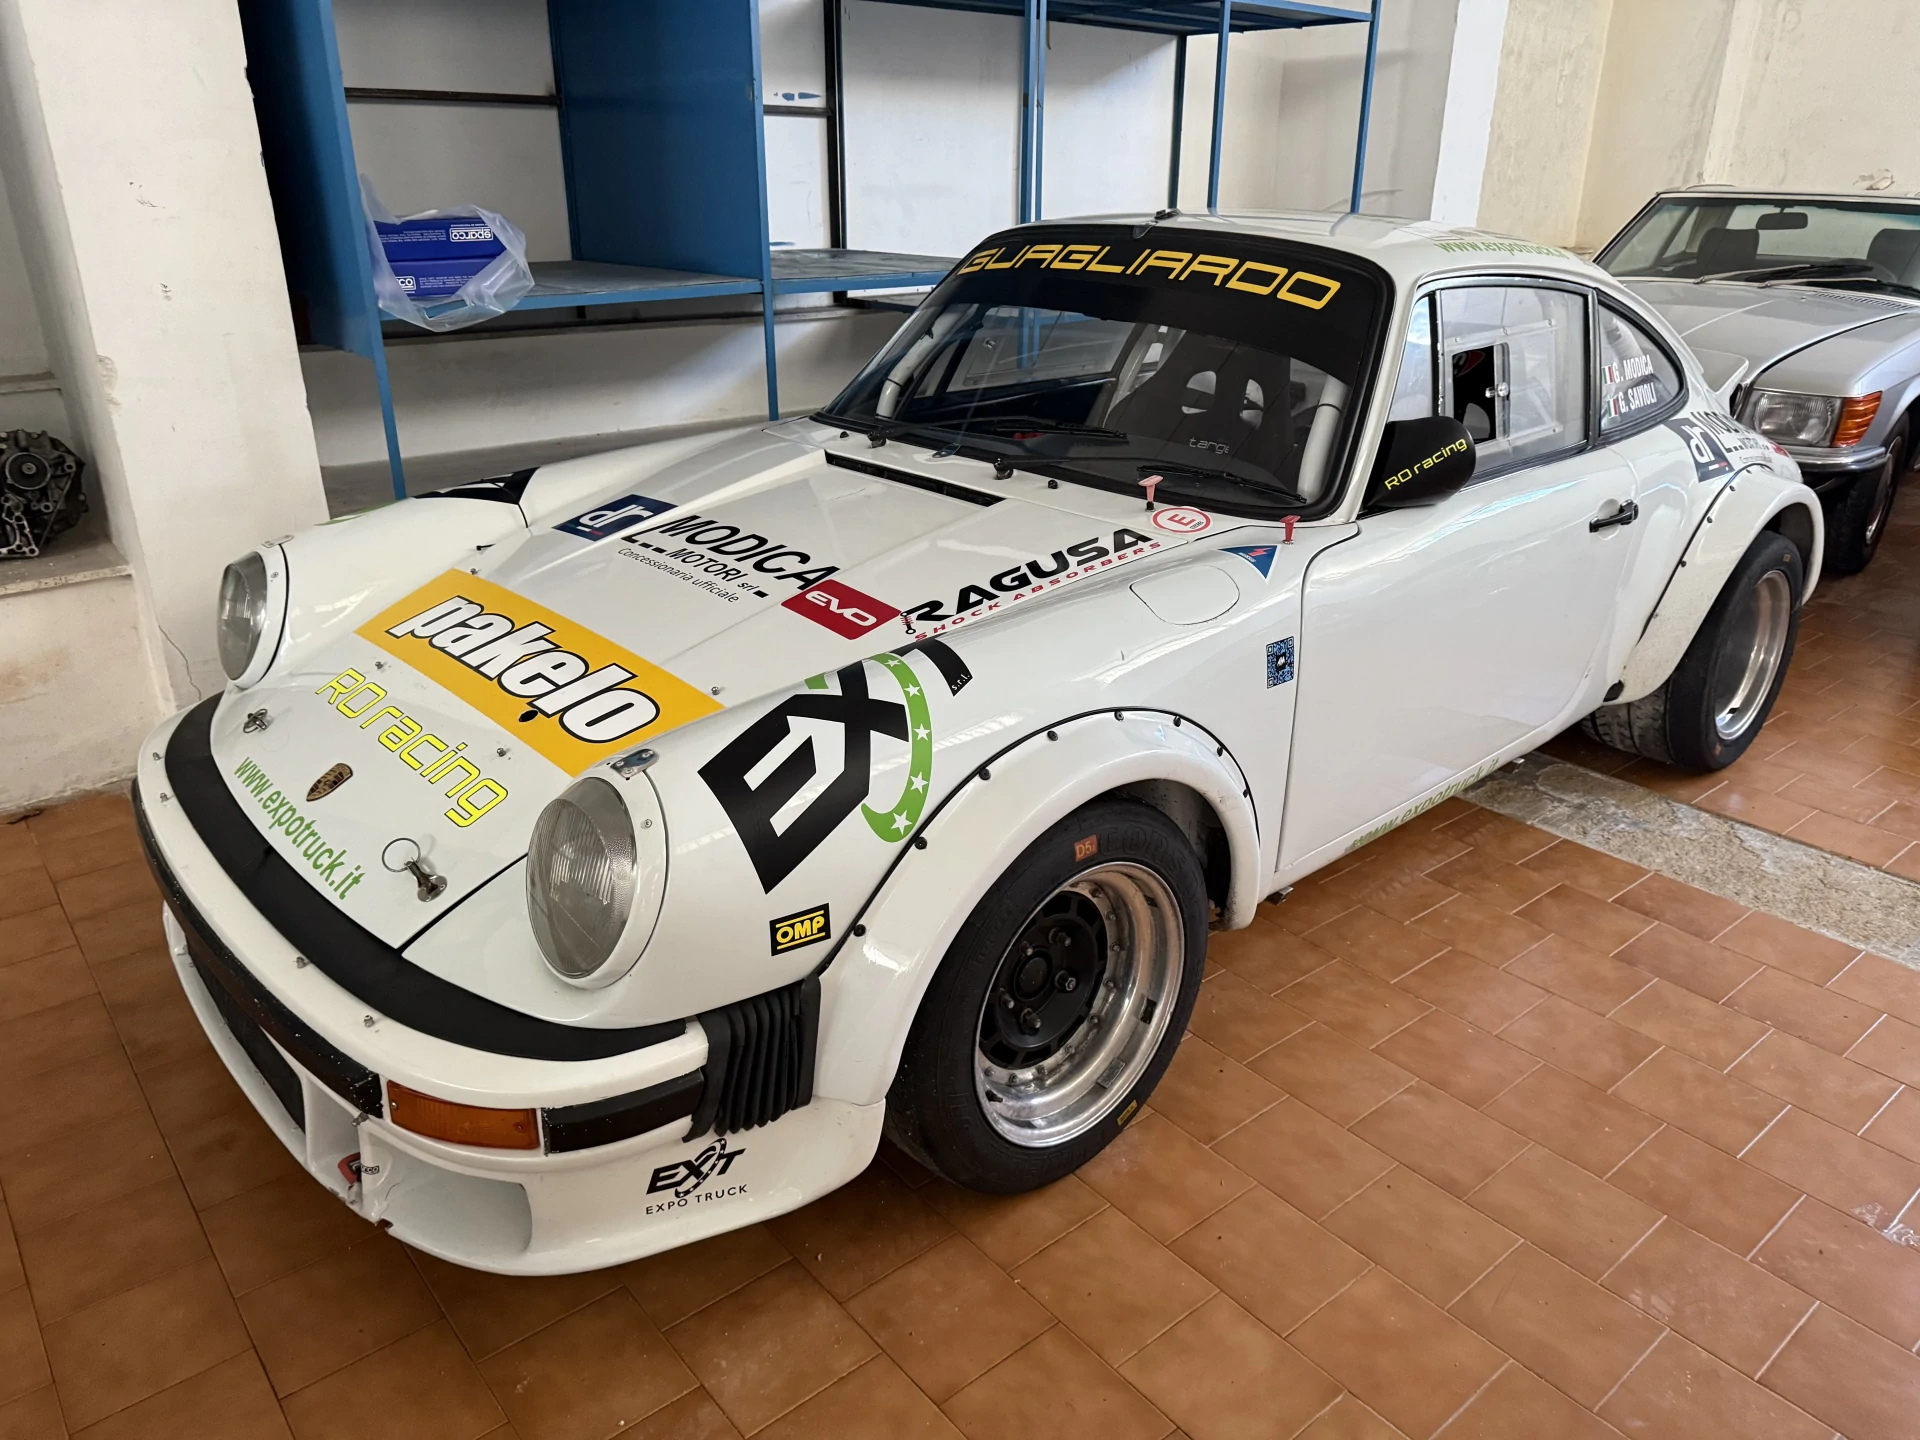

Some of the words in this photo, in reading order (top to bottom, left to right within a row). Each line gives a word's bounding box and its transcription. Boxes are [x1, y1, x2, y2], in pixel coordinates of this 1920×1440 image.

[451, 229, 493, 241] sparco
[958, 244, 1341, 310] GUAGLIARDO
[1612, 361, 1624, 384] G.
[1622, 353, 1654, 381] MODICA
[1618, 391, 1629, 414] G.
[1627, 381, 1658, 411] SAVIOLI
[1384, 468, 1413, 490] RO
[1413, 438, 1468, 475] racing
[616, 546, 694, 583] Concessionaria
[691, 575, 740, 604] ufficiale
[653, 514, 841, 591] MODICA
[665, 547, 748, 583] MOTORI
[736, 579, 757, 593] srl
[903, 528, 1154, 622] RAGUSA
[804, 590, 878, 627] EVO
[914, 600, 1002, 642] SHOCK
[1012, 541, 1162, 601] ABSORBERS
[384, 595, 661, 744] pakelo
[951, 673, 971, 691] s.r.l.
[314, 667, 388, 720] RO
[359, 698, 509, 828] racing
[233, 756, 366, 900] www.expotruck.it
[776, 915, 825, 944] OMP
[645, 1198, 689, 1216] EXPO
[694, 1183, 749, 1204] TRUCK
